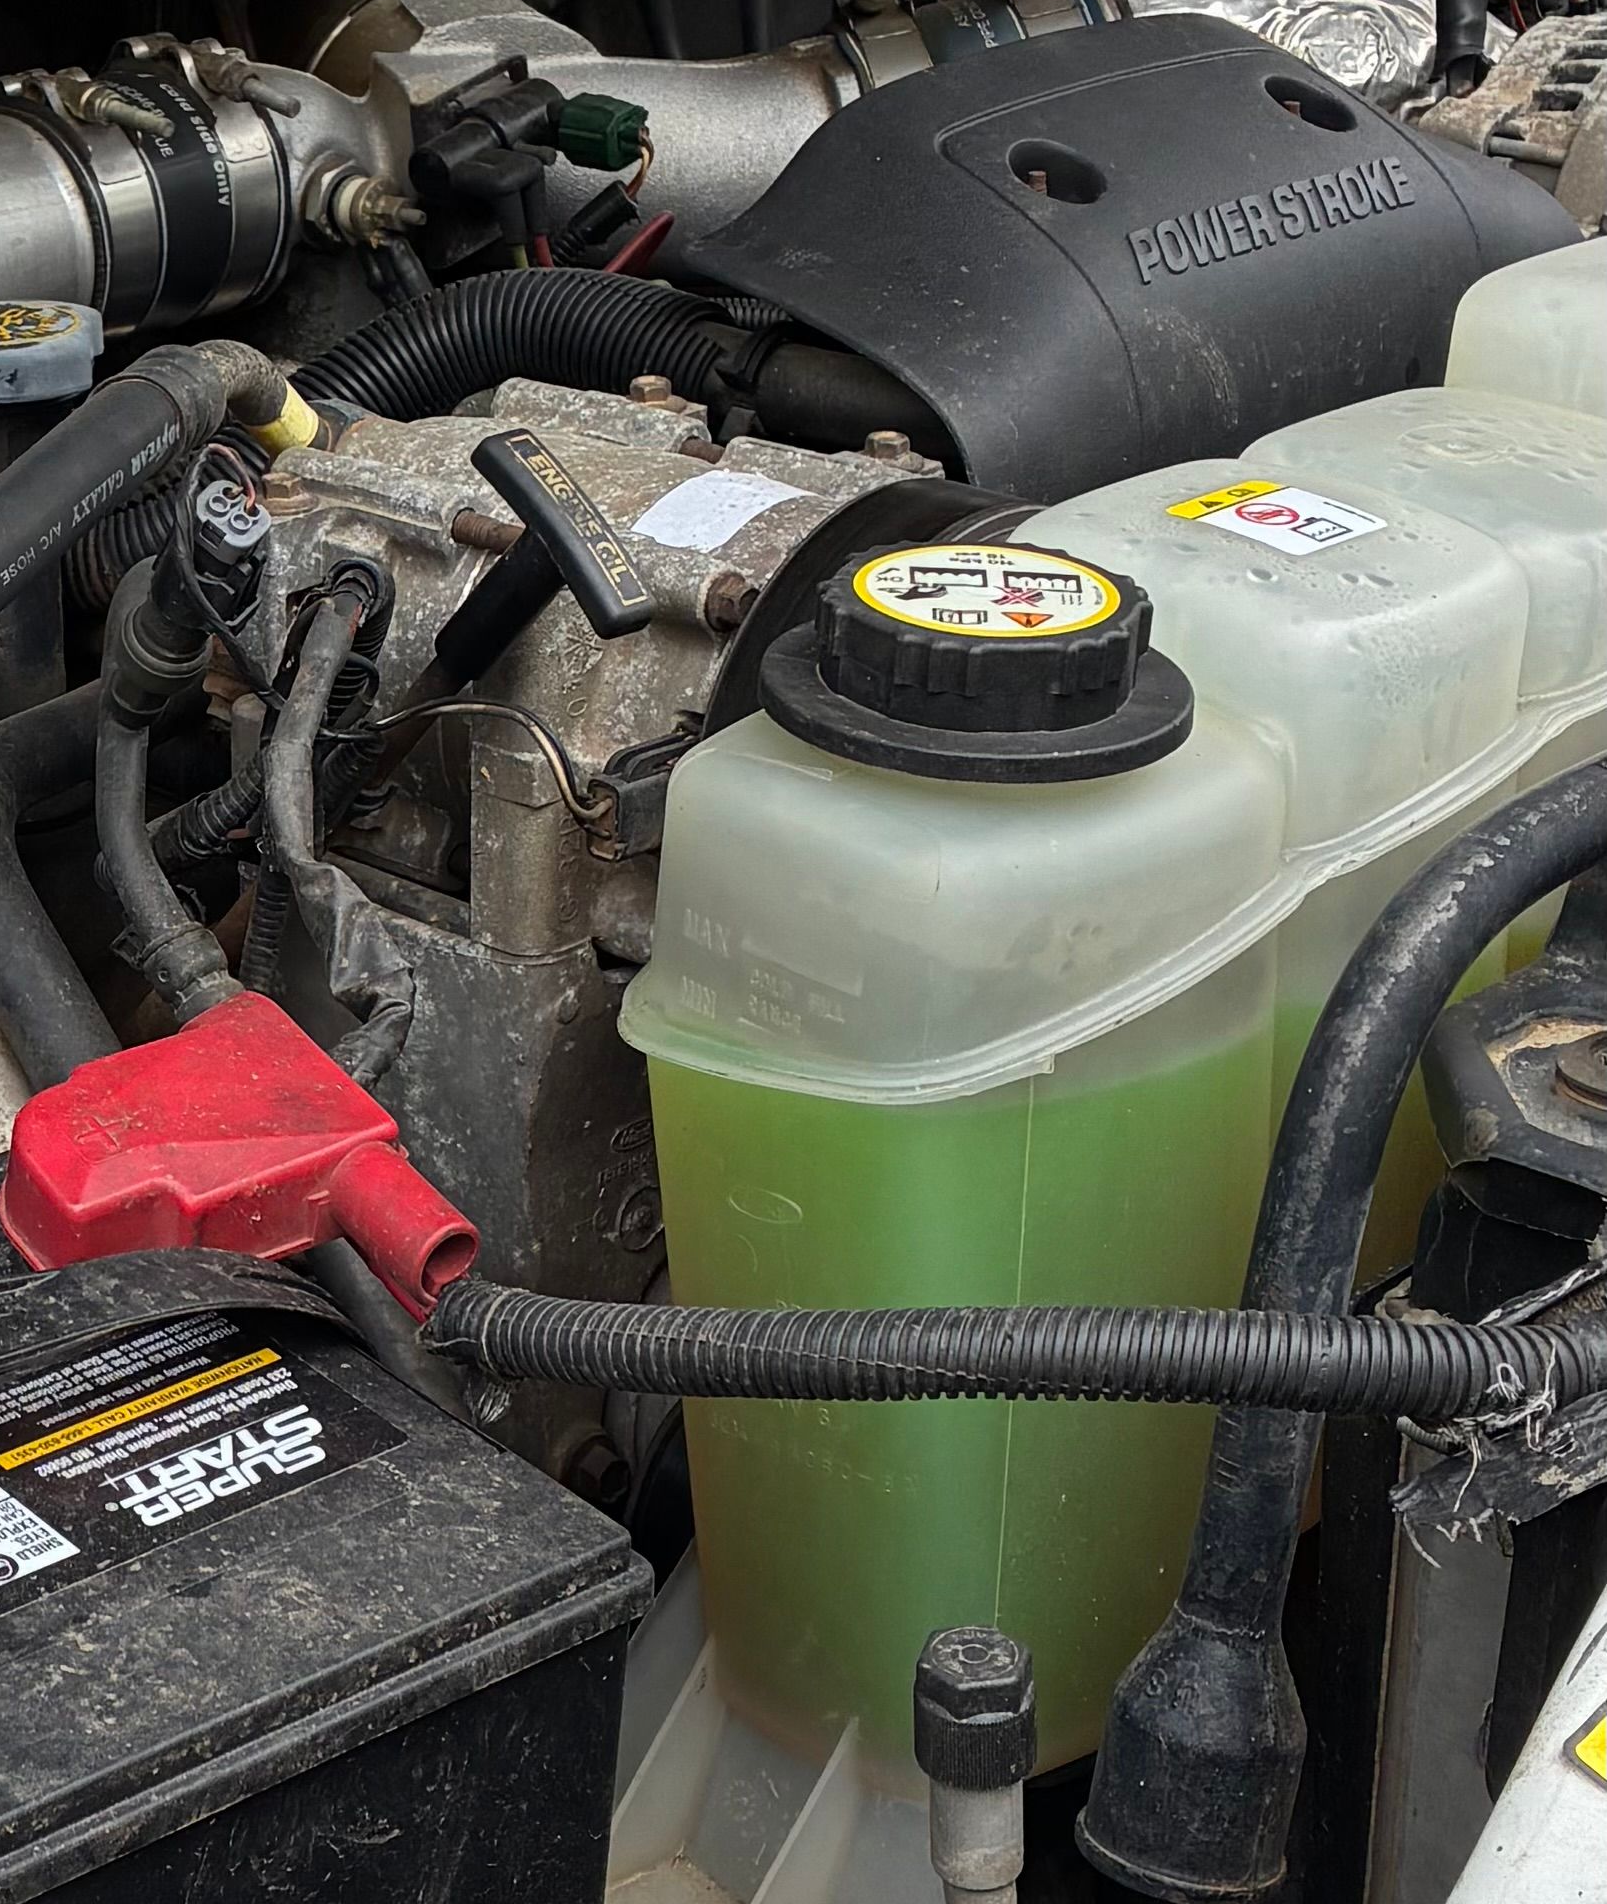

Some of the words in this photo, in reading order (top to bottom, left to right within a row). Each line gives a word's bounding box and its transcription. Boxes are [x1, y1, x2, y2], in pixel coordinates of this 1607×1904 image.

[1127, 195, 1278, 285] POWER
[1270, 155, 1415, 239] STROKE
[71, 468, 124, 528] GALAXY
[40, 522, 62, 550] A/C
[0, 550, 36, 587] HOSE
[191, 1356, 263, 1387] NATIONWIDE
[127, 1385, 191, 1414] WARRANTY
[91, 1411, 125, 1426] CALL
[120, 1404, 323, 1507] START
[133, 1436, 326, 1527] SUPER
[0, 1509, 25, 1522] CAN
[10, 1527, 50, 1545] EYES.
[15, 1537, 62, 1560] SHIELD
